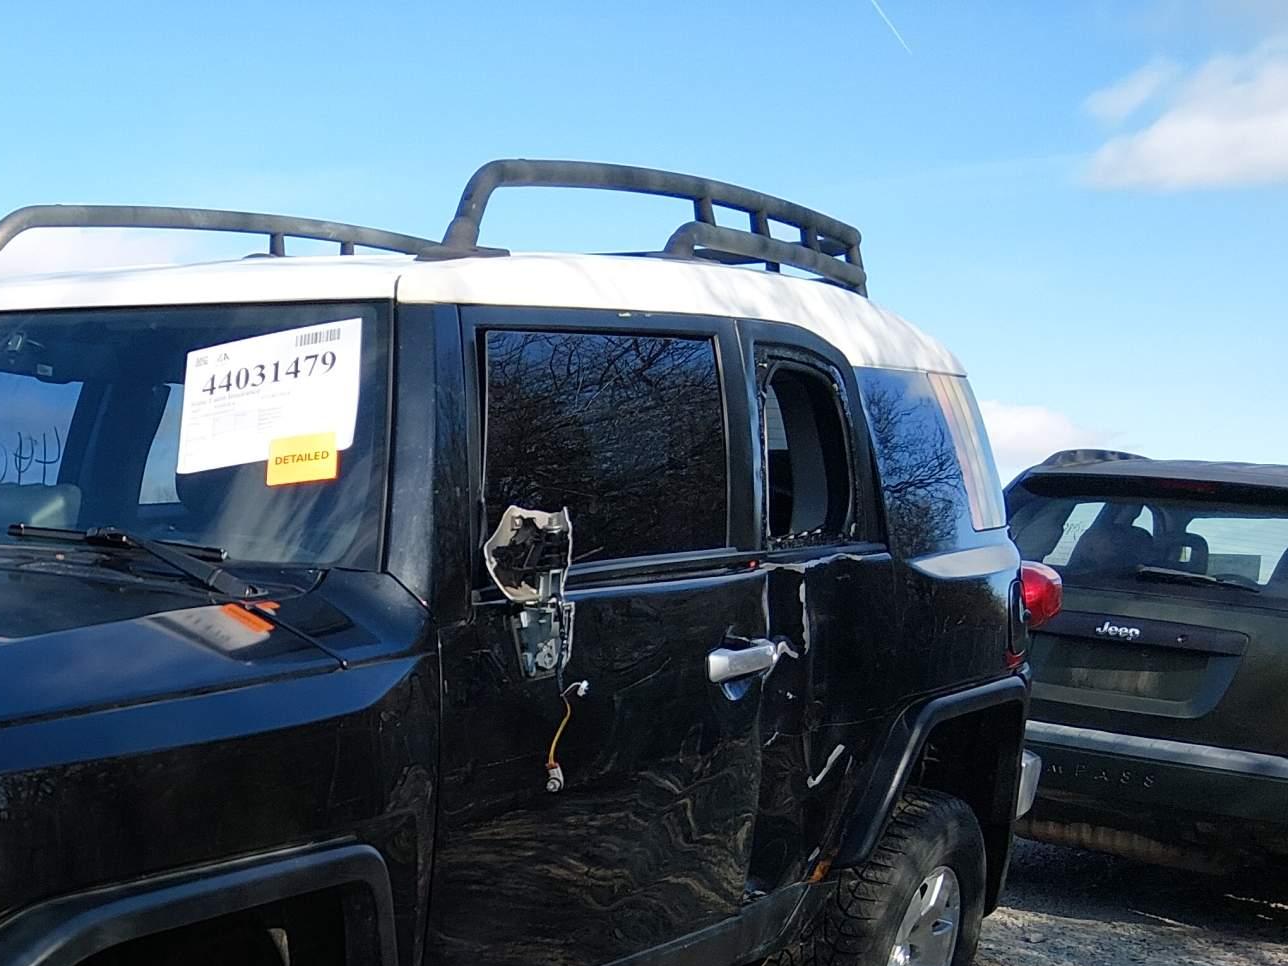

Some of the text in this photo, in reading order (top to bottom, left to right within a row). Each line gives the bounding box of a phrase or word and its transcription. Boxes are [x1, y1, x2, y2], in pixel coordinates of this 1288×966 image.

[202, 351, 337, 395] 44031479
[275, 451, 329, 466] DETAILED
[1096, 621, 1140, 640] Jeep
